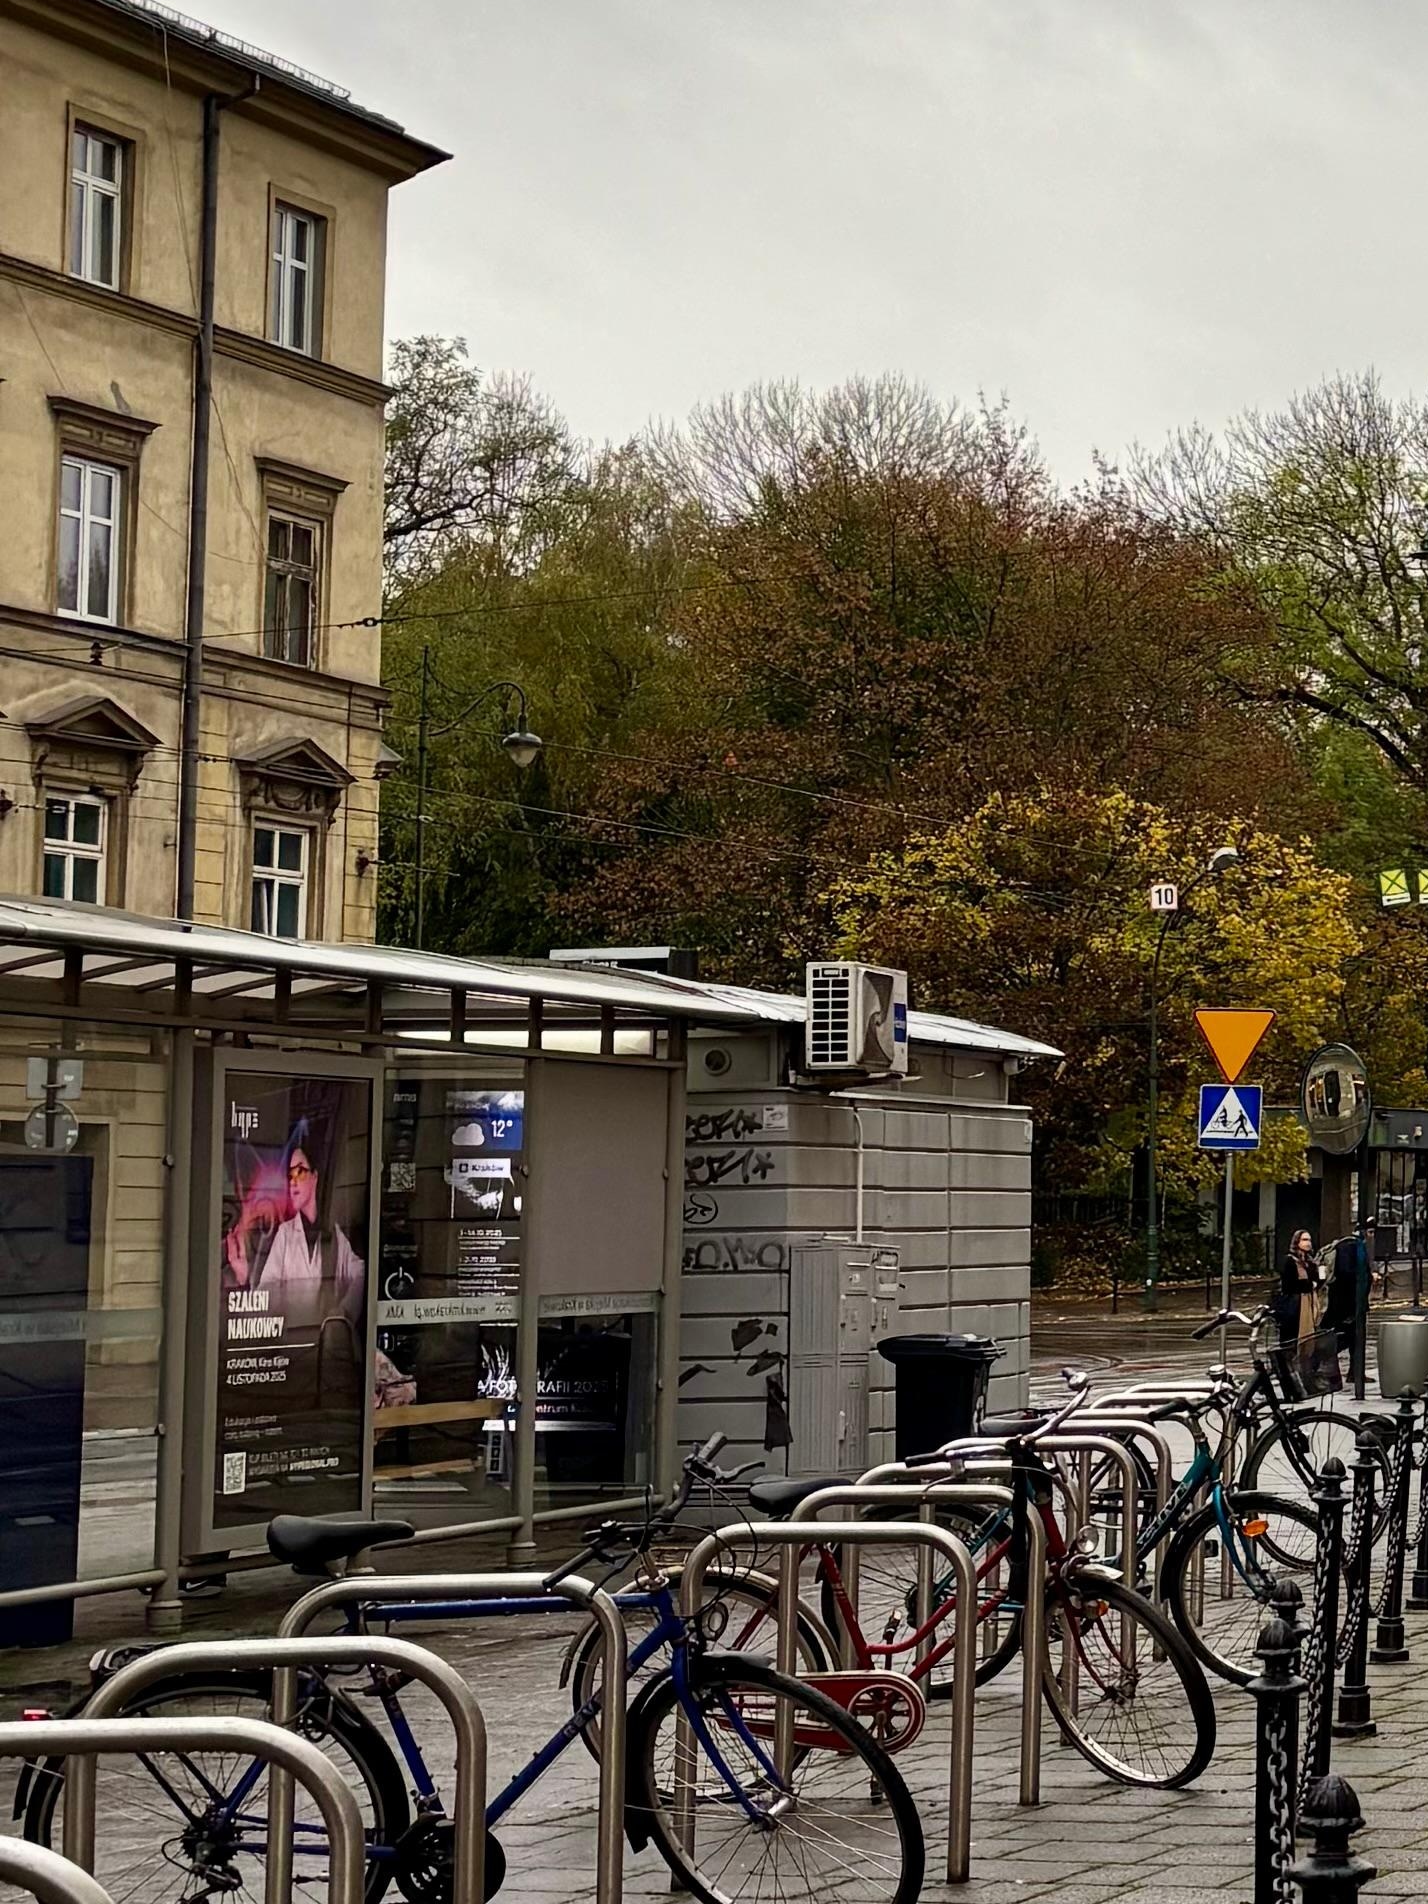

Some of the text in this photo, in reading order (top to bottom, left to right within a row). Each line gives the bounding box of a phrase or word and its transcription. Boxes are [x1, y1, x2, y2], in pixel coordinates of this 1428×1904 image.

[1154, 888, 1174, 905] 10
[228, 1290, 270, 1313] SZALENI
[227, 1316, 285, 1340] NAUKOWCY
